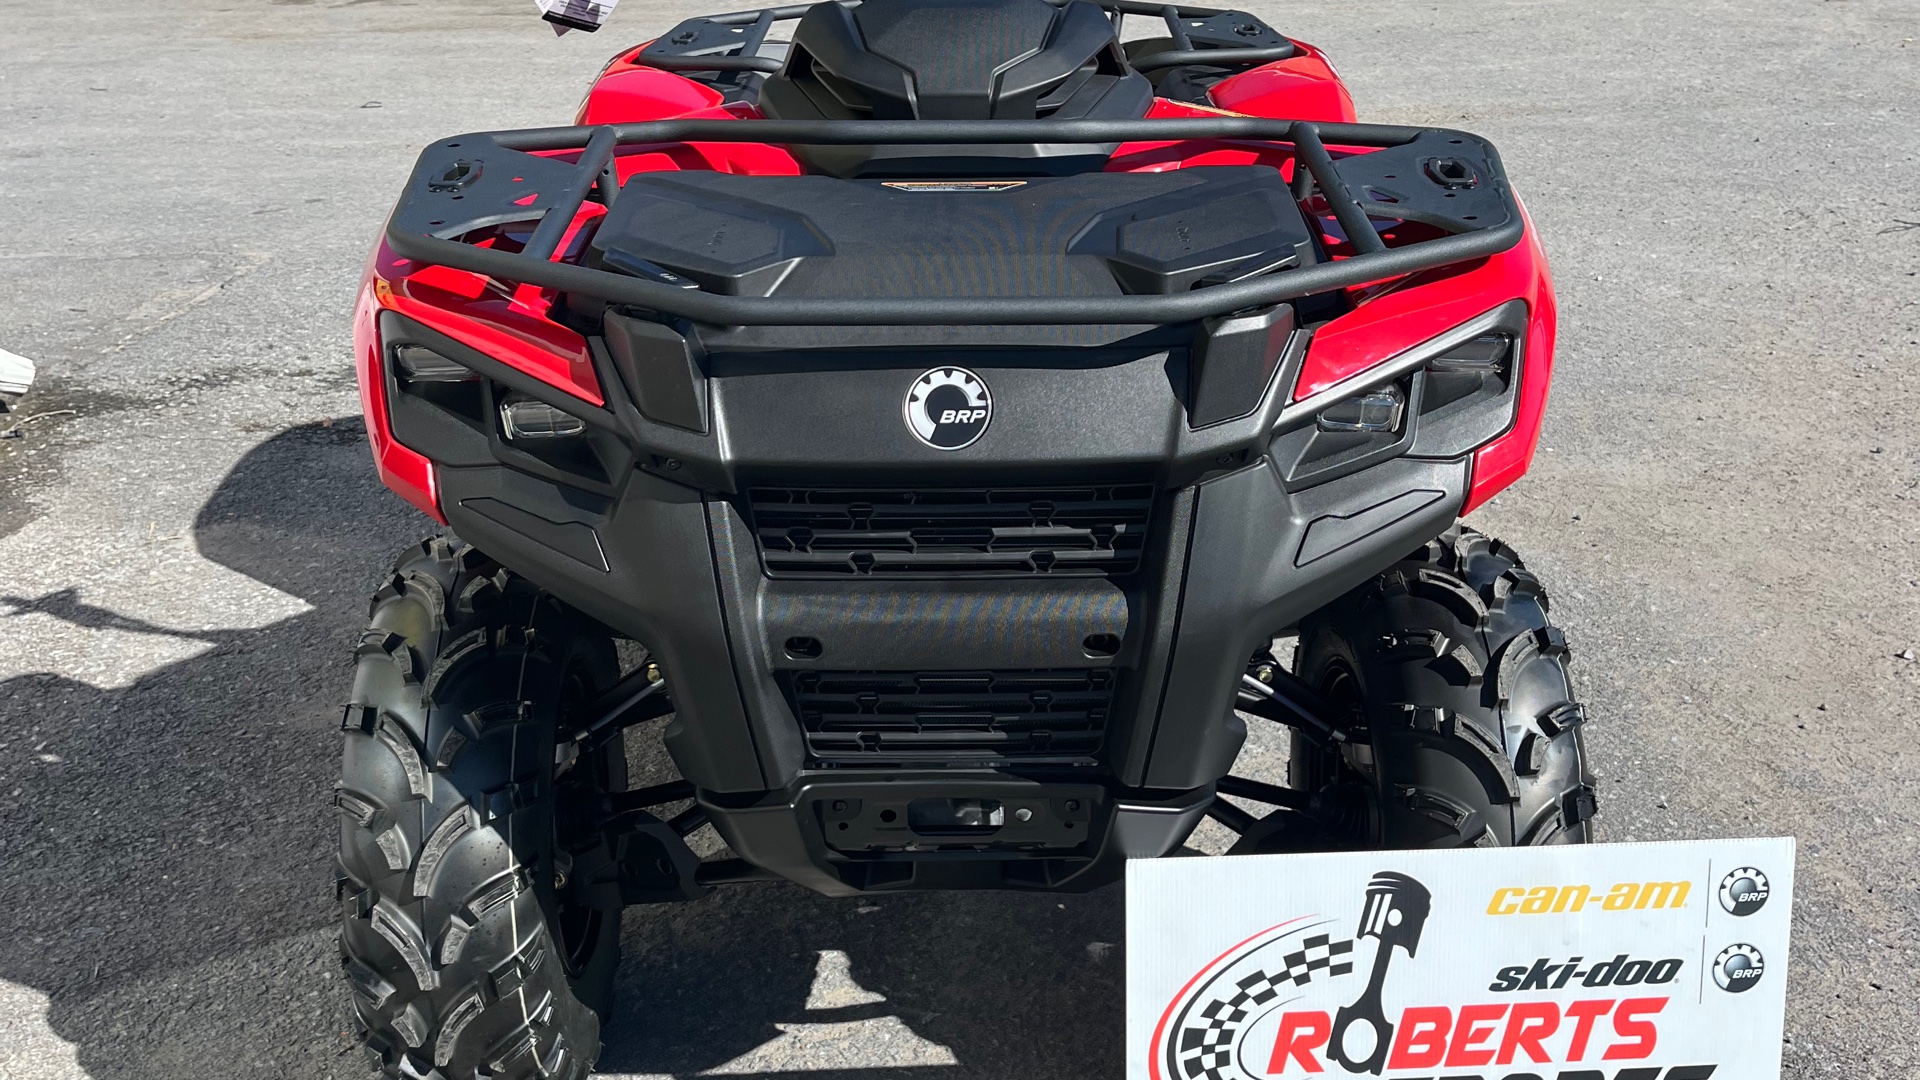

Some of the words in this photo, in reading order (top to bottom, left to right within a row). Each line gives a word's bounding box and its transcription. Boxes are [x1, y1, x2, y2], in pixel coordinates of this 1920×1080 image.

[940, 409, 986, 424] BRP
[1486, 881, 1692, 915] can-am
[1739, 891, 1768, 902] BRP
[1488, 954, 1684, 992] ski-doo
[1733, 967, 1763, 979] BRP
[1266, 996, 1670, 1075] ROBERTS
